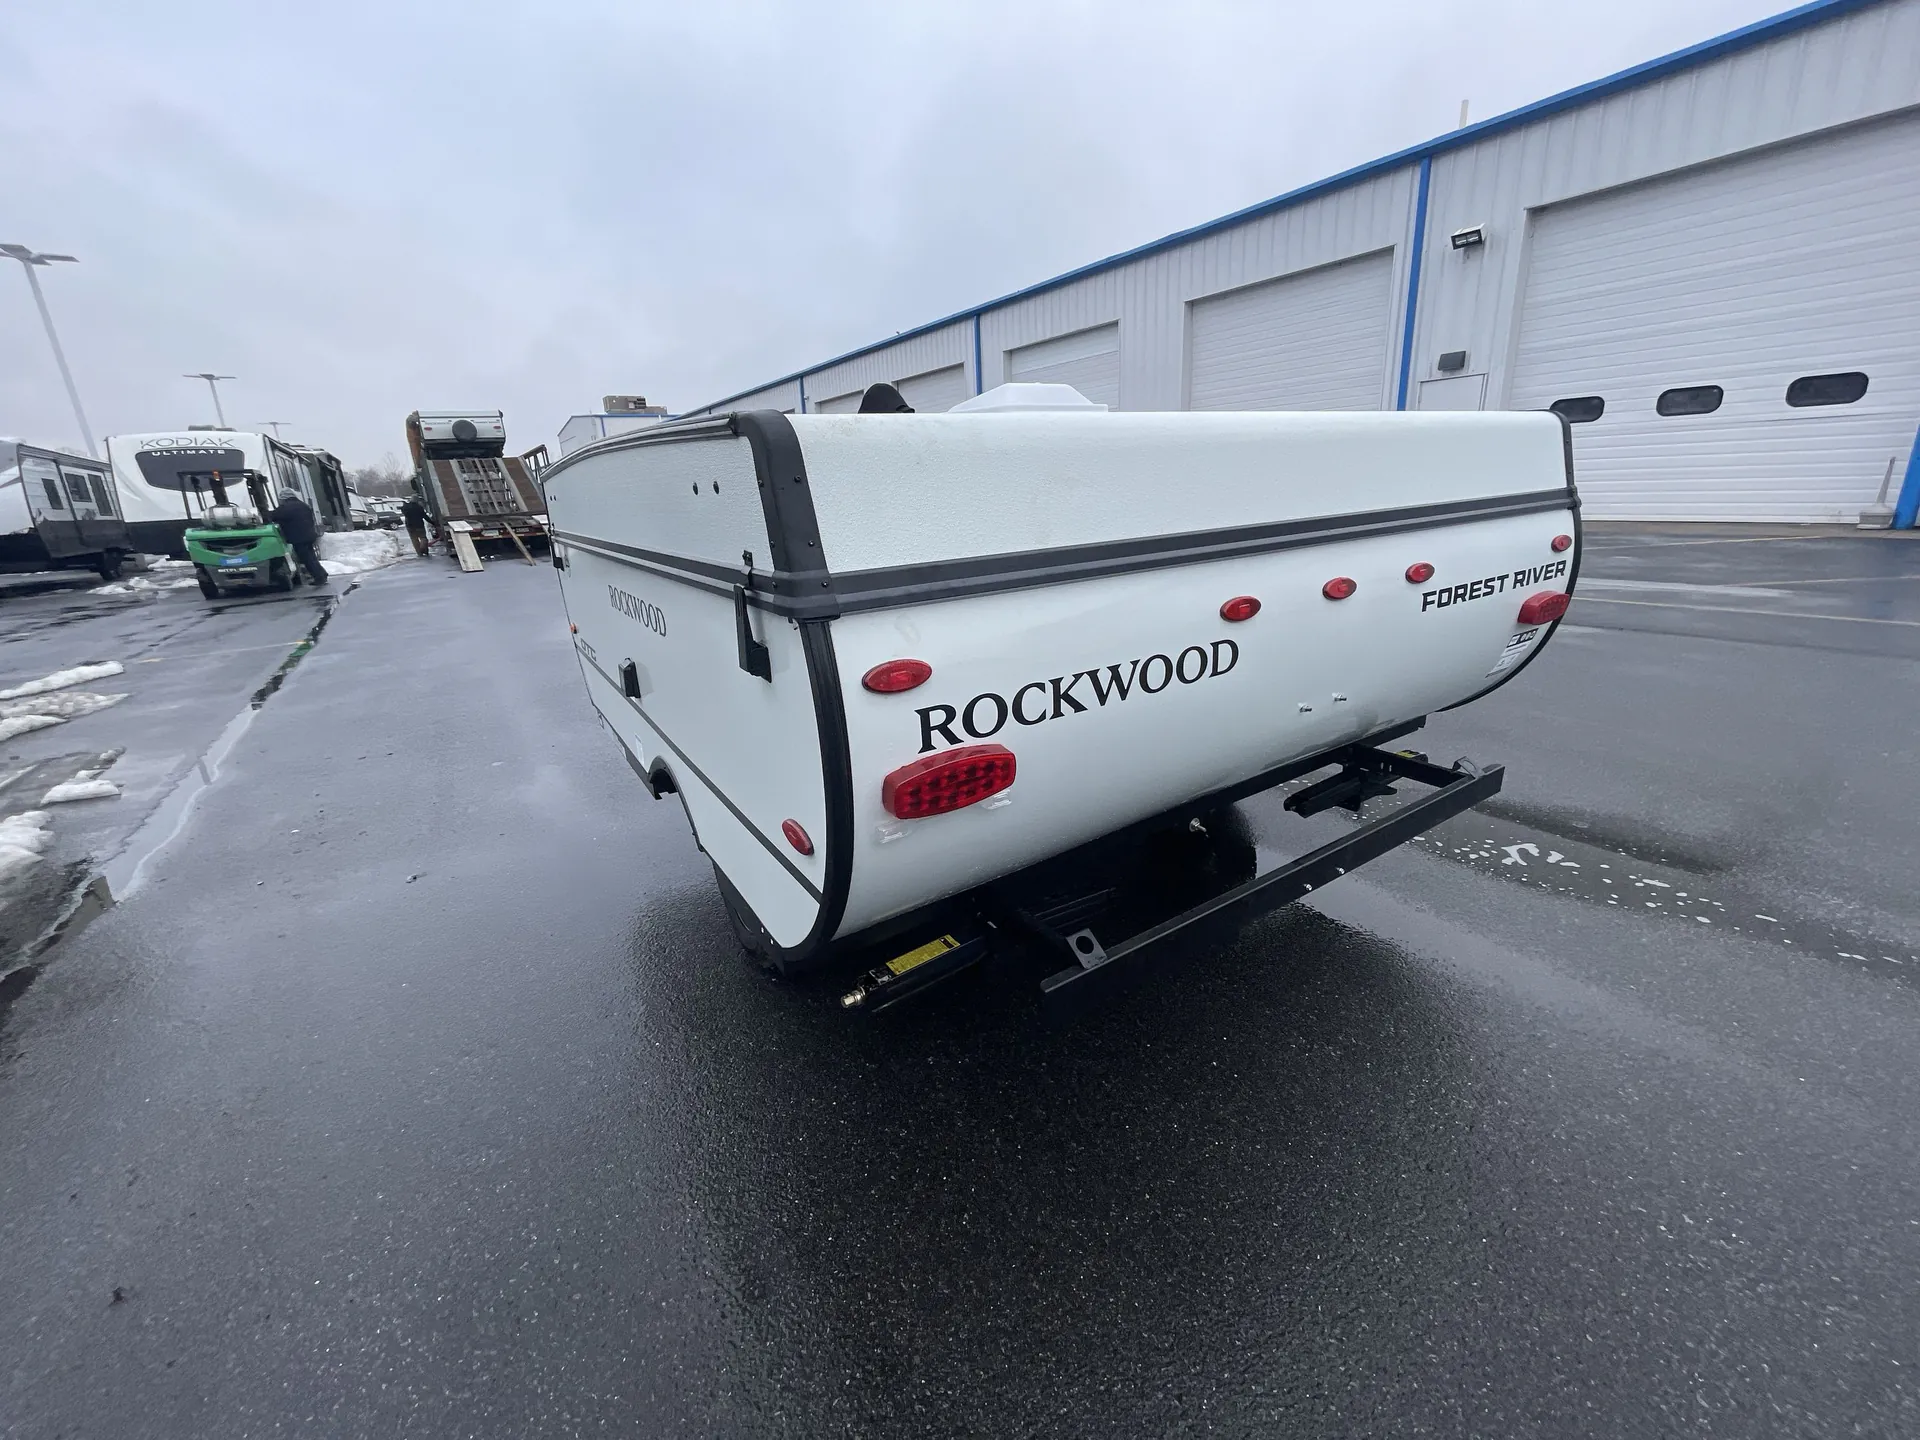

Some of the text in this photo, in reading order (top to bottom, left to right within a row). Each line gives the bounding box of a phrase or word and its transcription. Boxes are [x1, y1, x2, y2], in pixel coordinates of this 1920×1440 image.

[140, 437, 236, 449] KODIAK
[608, 585, 666, 637] ROCKWOOD
[1422, 560, 1566, 612] FOREST RIVER
[914, 638, 1240, 754] ROCKWOOD
